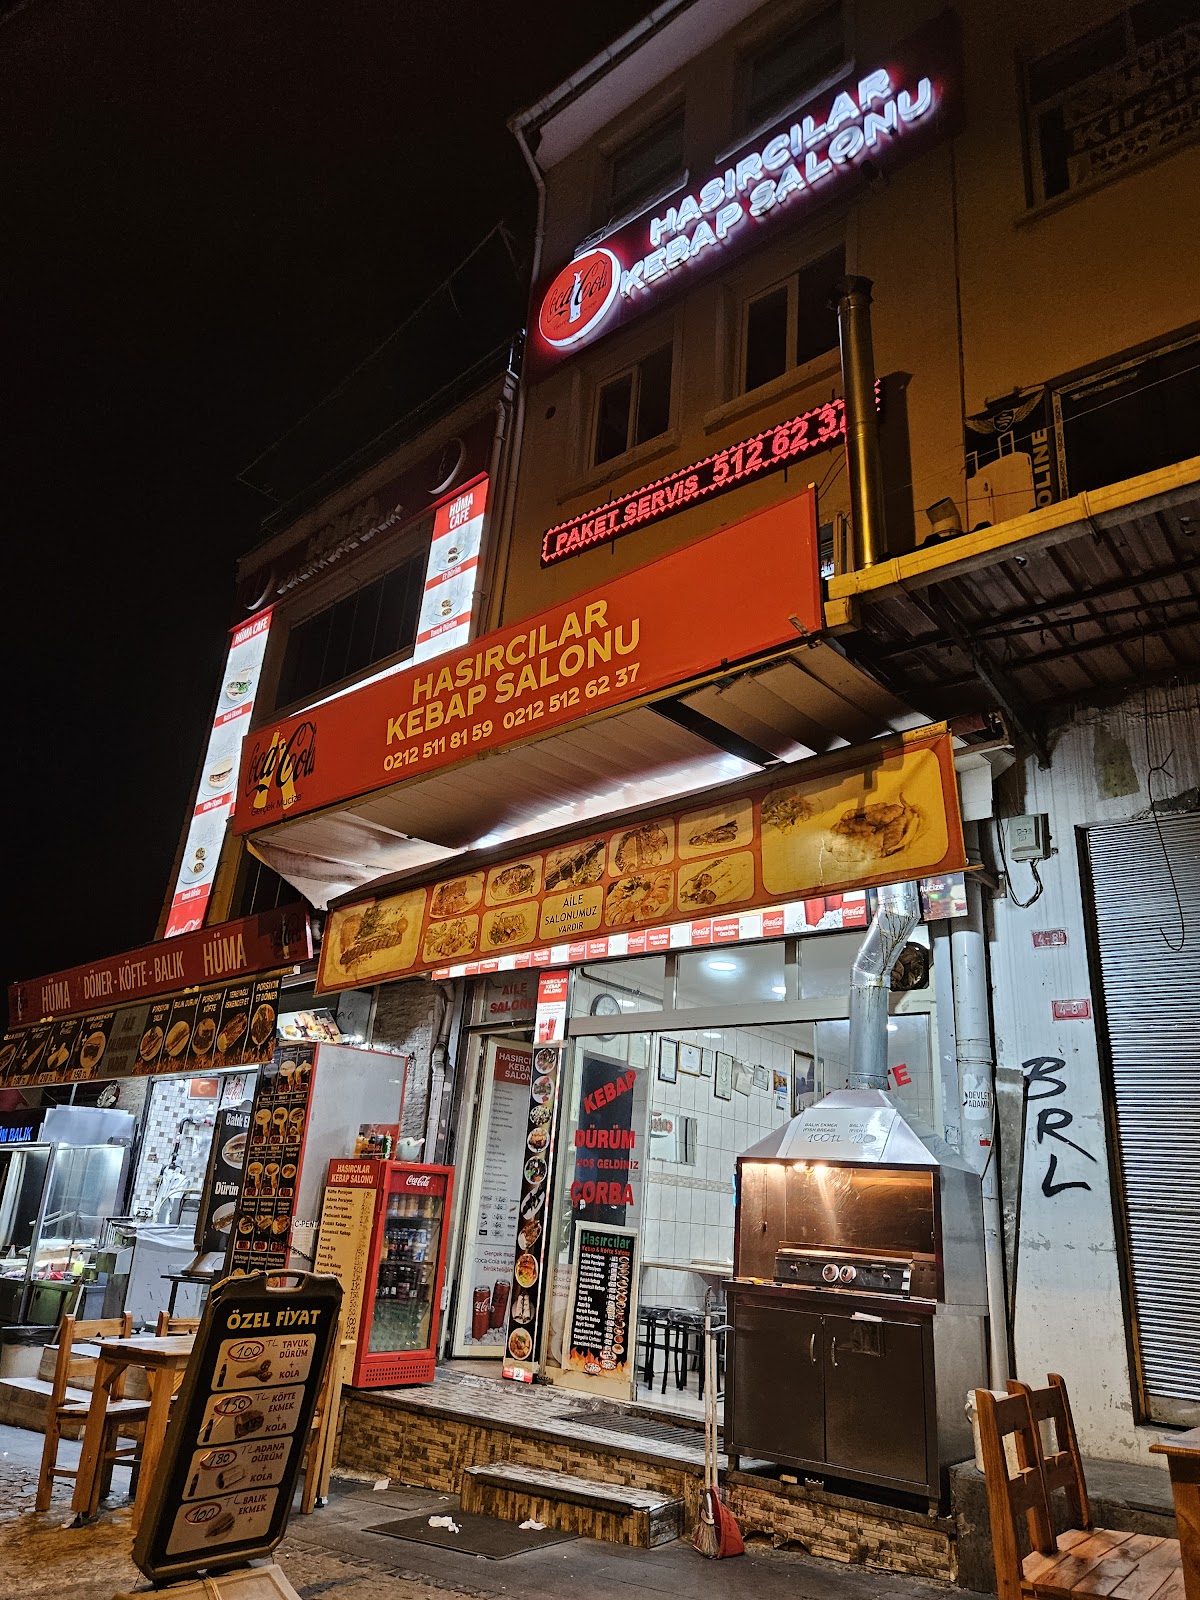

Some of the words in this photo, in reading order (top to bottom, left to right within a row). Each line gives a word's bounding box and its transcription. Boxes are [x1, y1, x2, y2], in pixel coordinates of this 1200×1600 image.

[650, 68, 892, 247] HASIRCILAR
[619, 202, 743, 299] KEBAP
[749, 77, 932, 217] SALONU
[555, 509, 619, 551] PAKET
[712, 441, 764, 483] 512
[771, 420, 809, 456] 62
[449, 493, 474, 518] HÜMA
[449, 507, 470, 530] CAFE
[234, 625, 253, 646] HÜMA
[252, 616, 269, 635] CAFE
[413, 599, 609, 706] HASIRCILAR
[386, 683, 488, 745] KEBAP
[495, 619, 641, 703] SALONU
[383, 750, 419, 771] 0212
[422, 738, 446, 760] 511
[449, 732, 469, 751] 81
[471, 720, 493, 743] 59
[503, 700, 545, 732] 0212
[548, 688, 580, 713] 512
[585, 678, 610, 700] 62
[614, 662, 641, 688] 37
[562, 894, 584, 908] AİLE
[545, 905, 598, 925] SALONUMUZ
[558, 921, 584, 934] VARDIR
[203, 932, 248, 976] HÜMA
[41, 979, 71, 1013] HÜMA
[83, 969, 113, 1000] DÖNER
[119, 960, 147, 992] KÖFTE
[154, 951, 185, 983] BALIK
[502, 982, 528, 996] AİLE
[583, 1069, 637, 1114] KEBAP
[8, 1126, 33, 1142] BALIK
[575, 1125, 635, 1149] DÜRÜM
[336, 1164, 370, 1174] HASIRCILAR
[331, 1174, 350, 1183] KEBAP
[350, 1174, 374, 1184] SALONU
[570, 1181, 634, 1208] ÇORBA
[582, 1232, 631, 1250] Hasırcılar
[227, 1308, 271, 1330] ÖZEL
[275, 1307, 322, 1327] FİYAT
[282, 1339, 309, 1348] TAVUK
[236, 1345, 261, 1359] 100
[279, 1349, 308, 1359] DÜRÜM
[279, 1370, 300, 1379] KOLA
[271, 1392, 296, 1402] KÖFTE
[222, 1400, 246, 1413] 150
[268, 1402, 295, 1413] EKMEK
[265, 1422, 287, 1432] KOLA
[255, 1442, 285, 1453] ADANA
[251, 1452, 282, 1463] DÜRÜM
[250, 1473, 273, 1482] KOLA
[242, 1494, 268, 1505] BALIK
[238, 1504, 268, 1515] EKMEK
